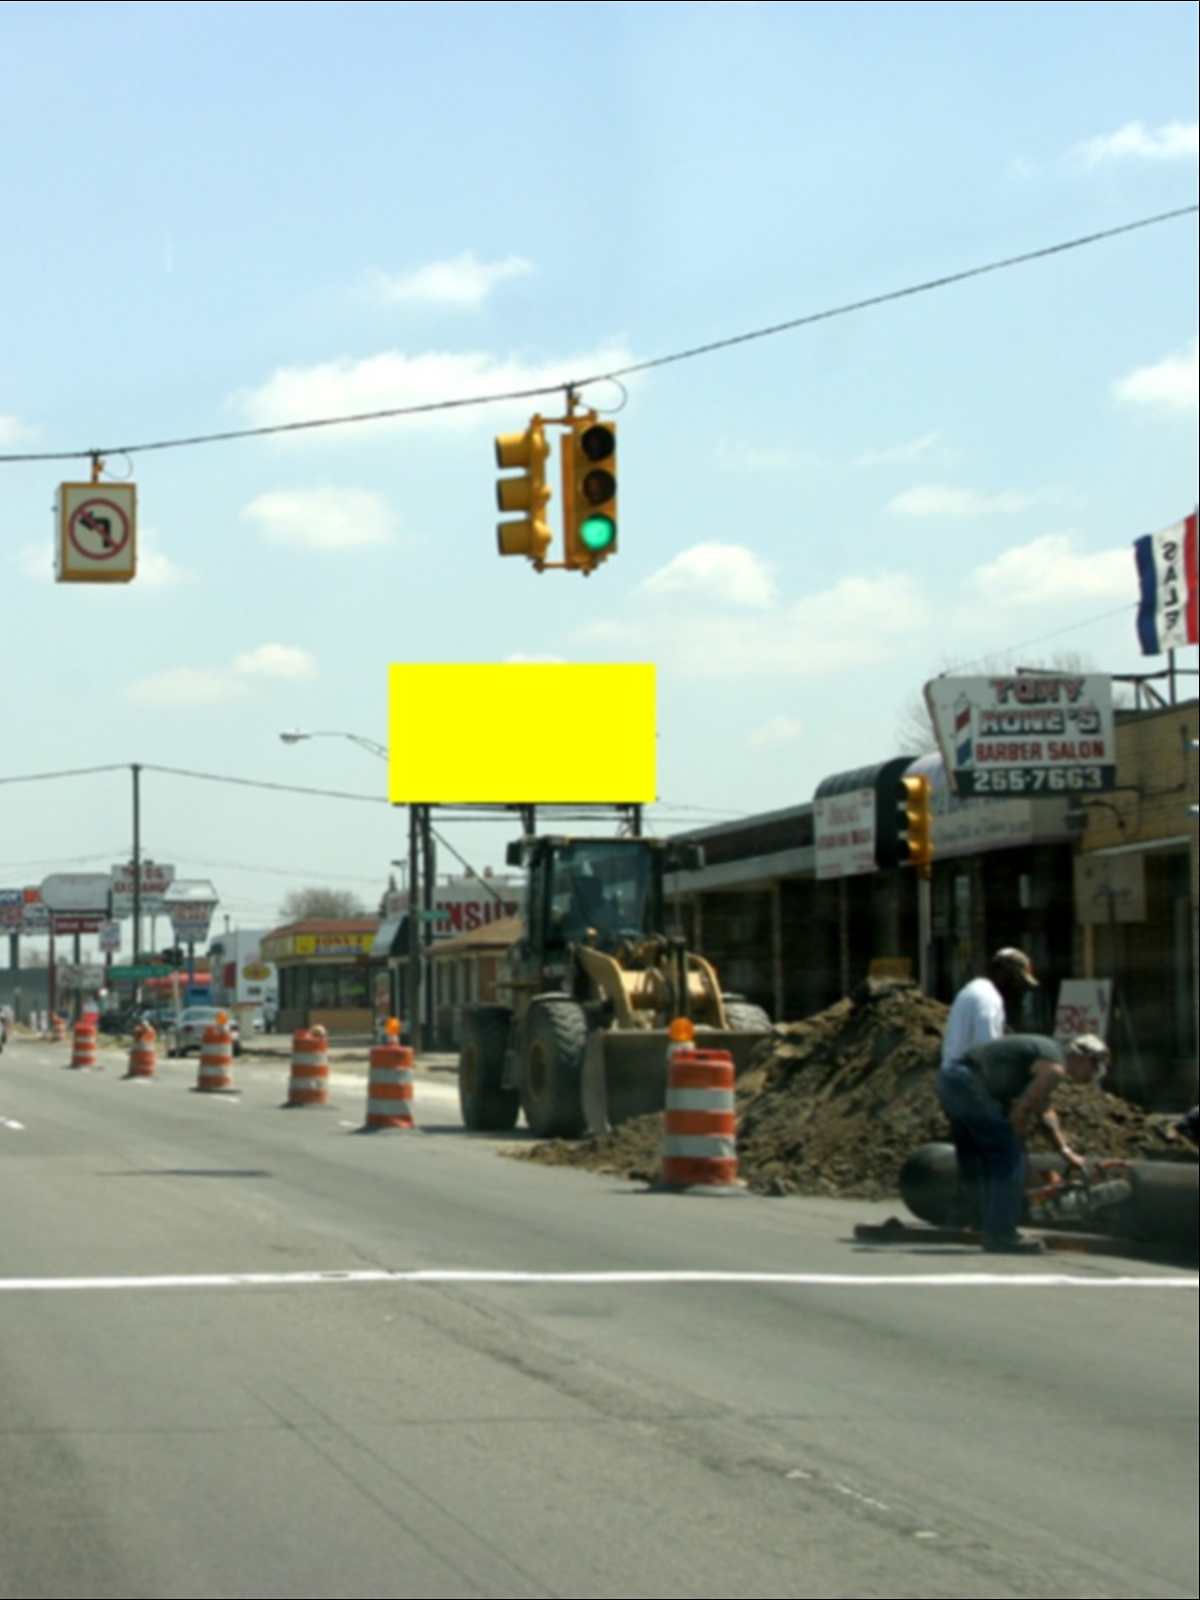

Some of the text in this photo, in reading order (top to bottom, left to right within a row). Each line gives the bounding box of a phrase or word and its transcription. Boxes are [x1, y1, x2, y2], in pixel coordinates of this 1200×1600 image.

[989, 678, 1084, 703] TONY
[976, 740, 1104, 762] BARBER SALON
